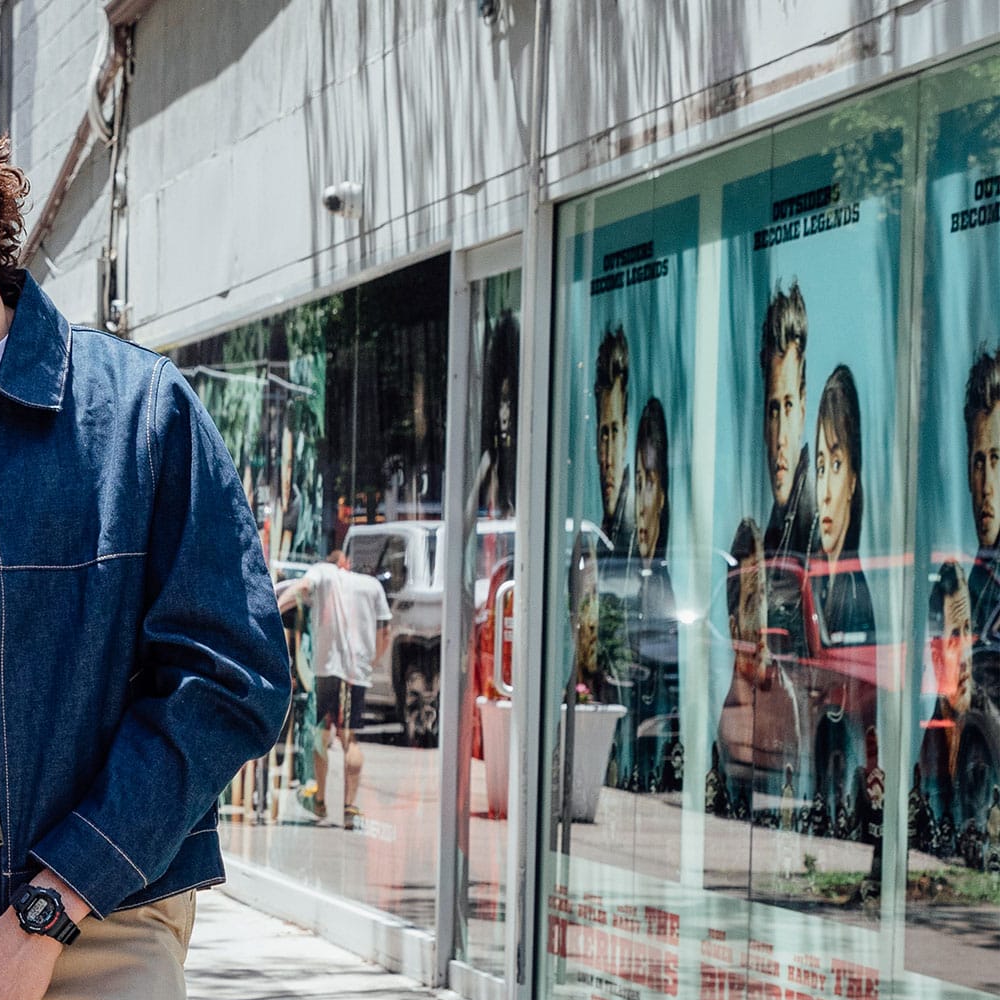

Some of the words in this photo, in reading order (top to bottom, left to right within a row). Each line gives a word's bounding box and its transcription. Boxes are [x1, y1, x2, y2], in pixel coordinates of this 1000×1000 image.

[772, 182, 841, 222] OUTSIDERS
[753, 220, 800, 251] BECOME
[803, 203, 860, 237] LEGENDS
